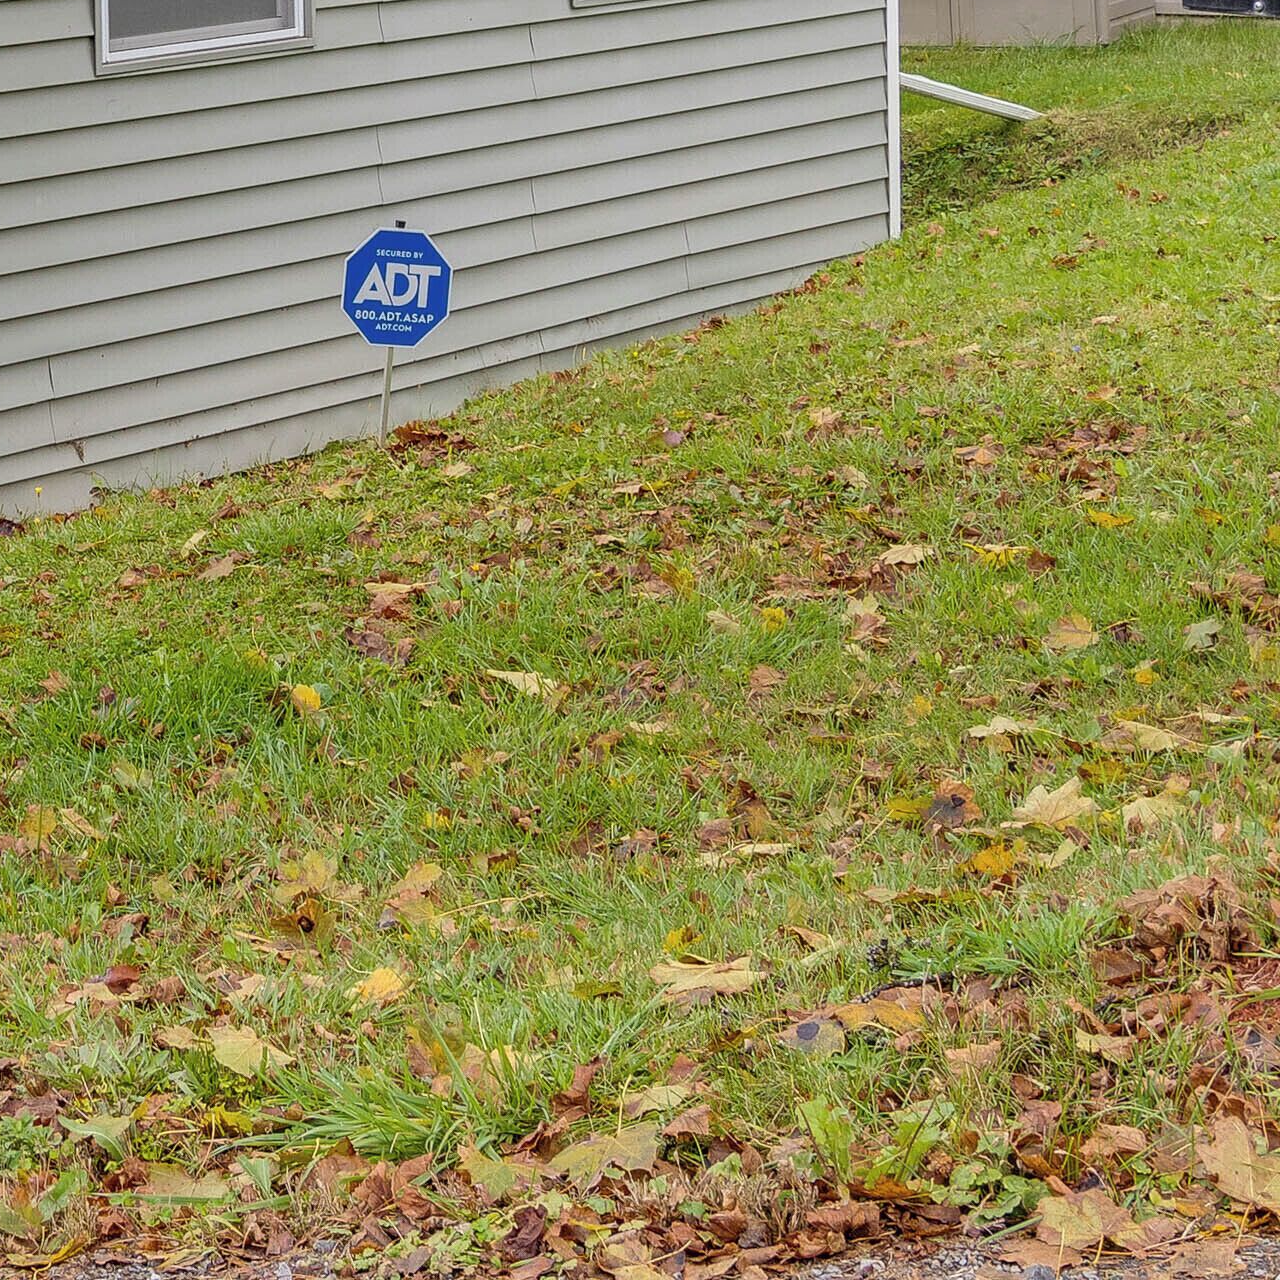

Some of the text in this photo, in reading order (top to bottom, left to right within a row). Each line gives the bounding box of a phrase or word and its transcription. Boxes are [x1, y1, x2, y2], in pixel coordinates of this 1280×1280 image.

[376, 249, 424, 259] SECURED BY
[352, 262, 442, 308] ADT
[355, 310, 434, 324] 800.ADT.ASAP
[375, 323, 412, 332] ADT.COM
